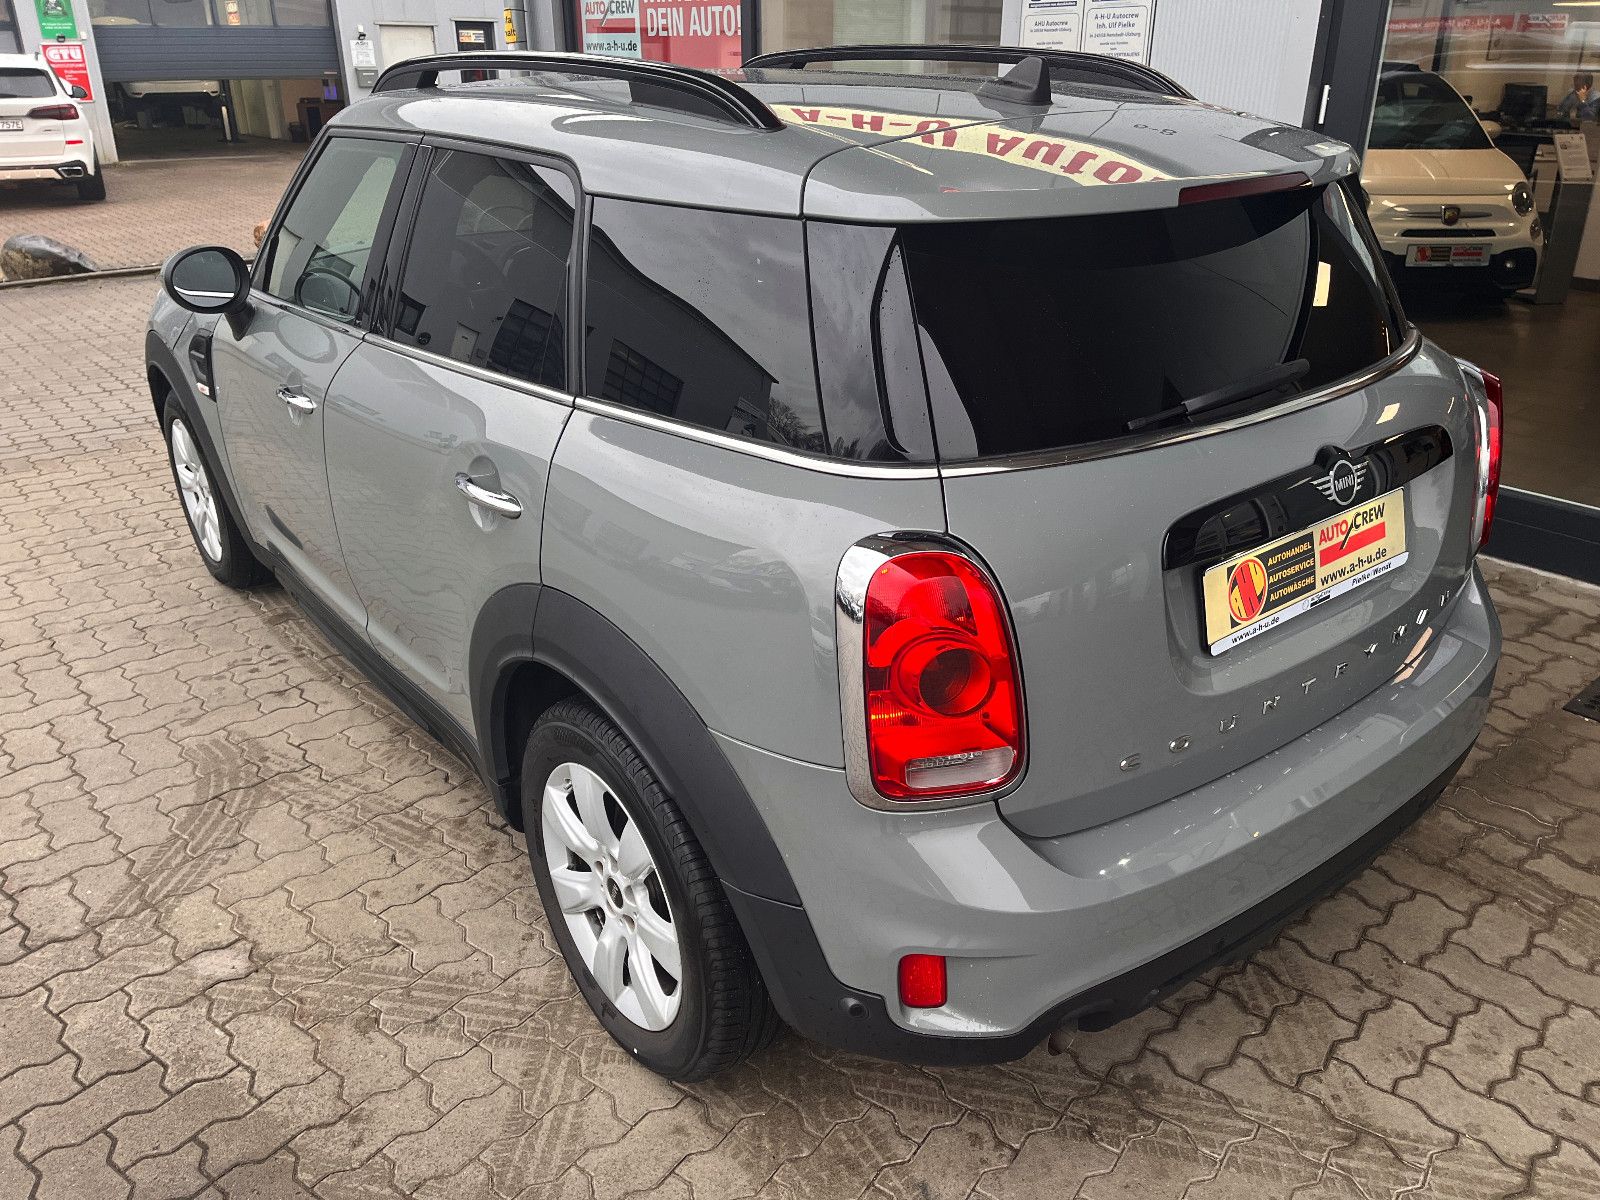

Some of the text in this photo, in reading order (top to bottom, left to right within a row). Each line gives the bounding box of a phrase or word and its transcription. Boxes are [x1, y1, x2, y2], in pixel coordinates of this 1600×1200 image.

[585, 0, 634, 15] AUTO CREW
[646, 5, 741, 37] DEIN AUTO!
[586, 40, 637, 52] www.a-h-u.de
[1334, 474, 1354, 491] MINI
[1319, 503, 1385, 546] AUTO CREW
[1268, 542, 1312, 567] AUTOHANDEL
[1320, 547, 1387, 587] www.a-h-u.de
[1269, 557, 1315, 584] AUTOSERVICE
[1270, 575, 1315, 602] AUTOWÄSCHE
[1231, 615, 1280, 645] www.a-h-u.de
